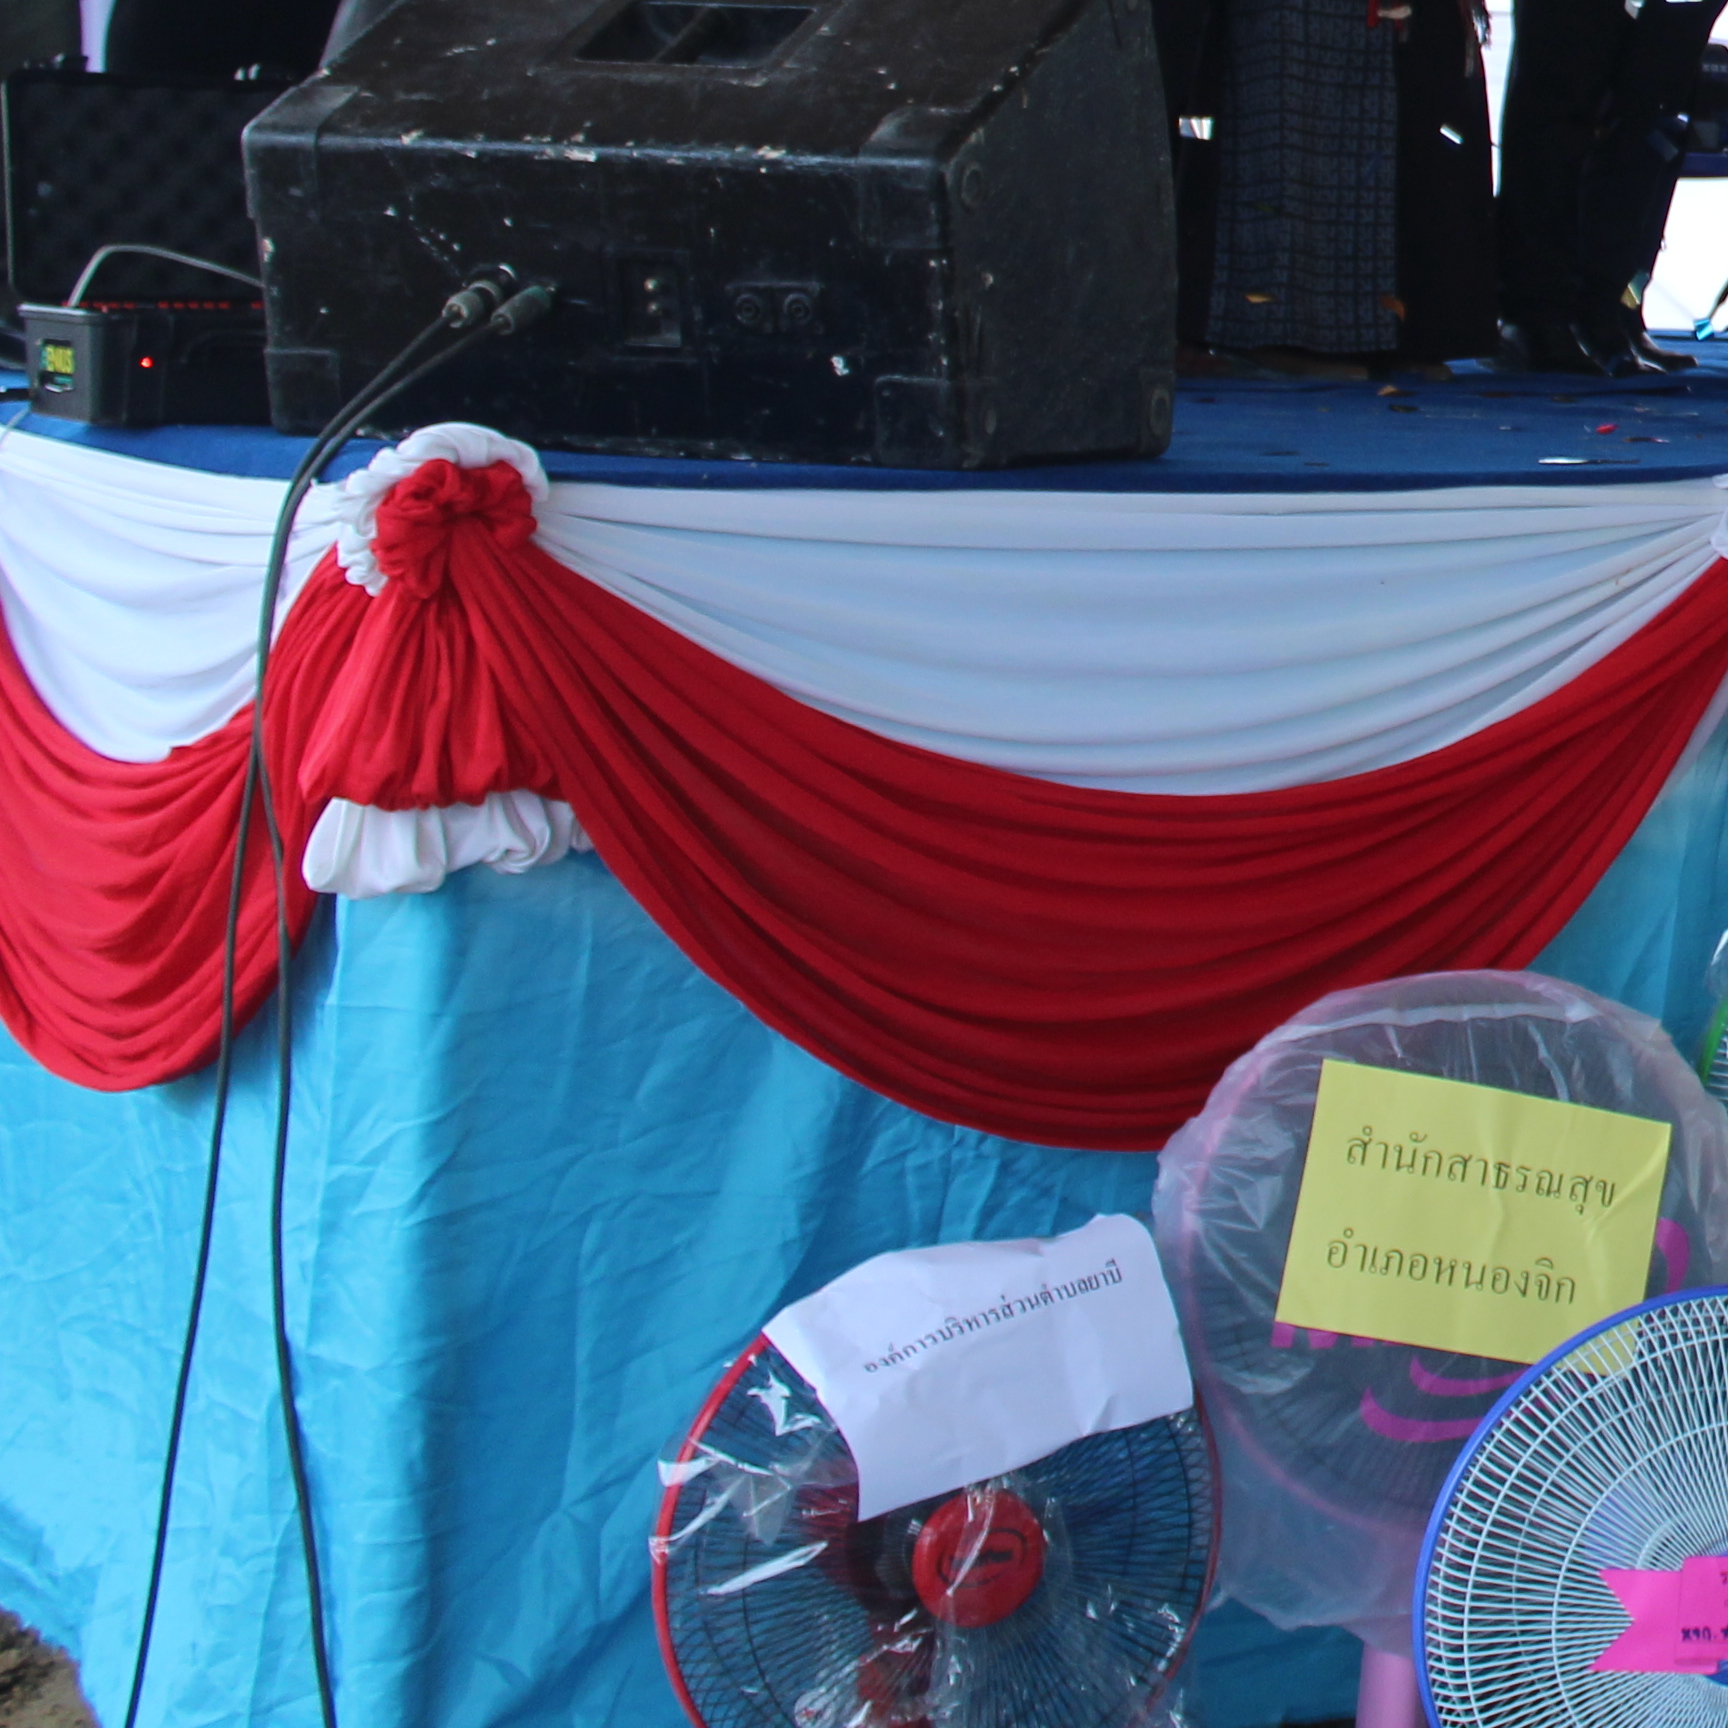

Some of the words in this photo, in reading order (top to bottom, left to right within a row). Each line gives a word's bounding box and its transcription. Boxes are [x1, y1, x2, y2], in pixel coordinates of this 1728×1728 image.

[1326, 1226, 1577, 1306] อำเภอหนองจิก
[863, 1258, 1123, 1374] องค์การบริหารส่วนตำบลยาบี
